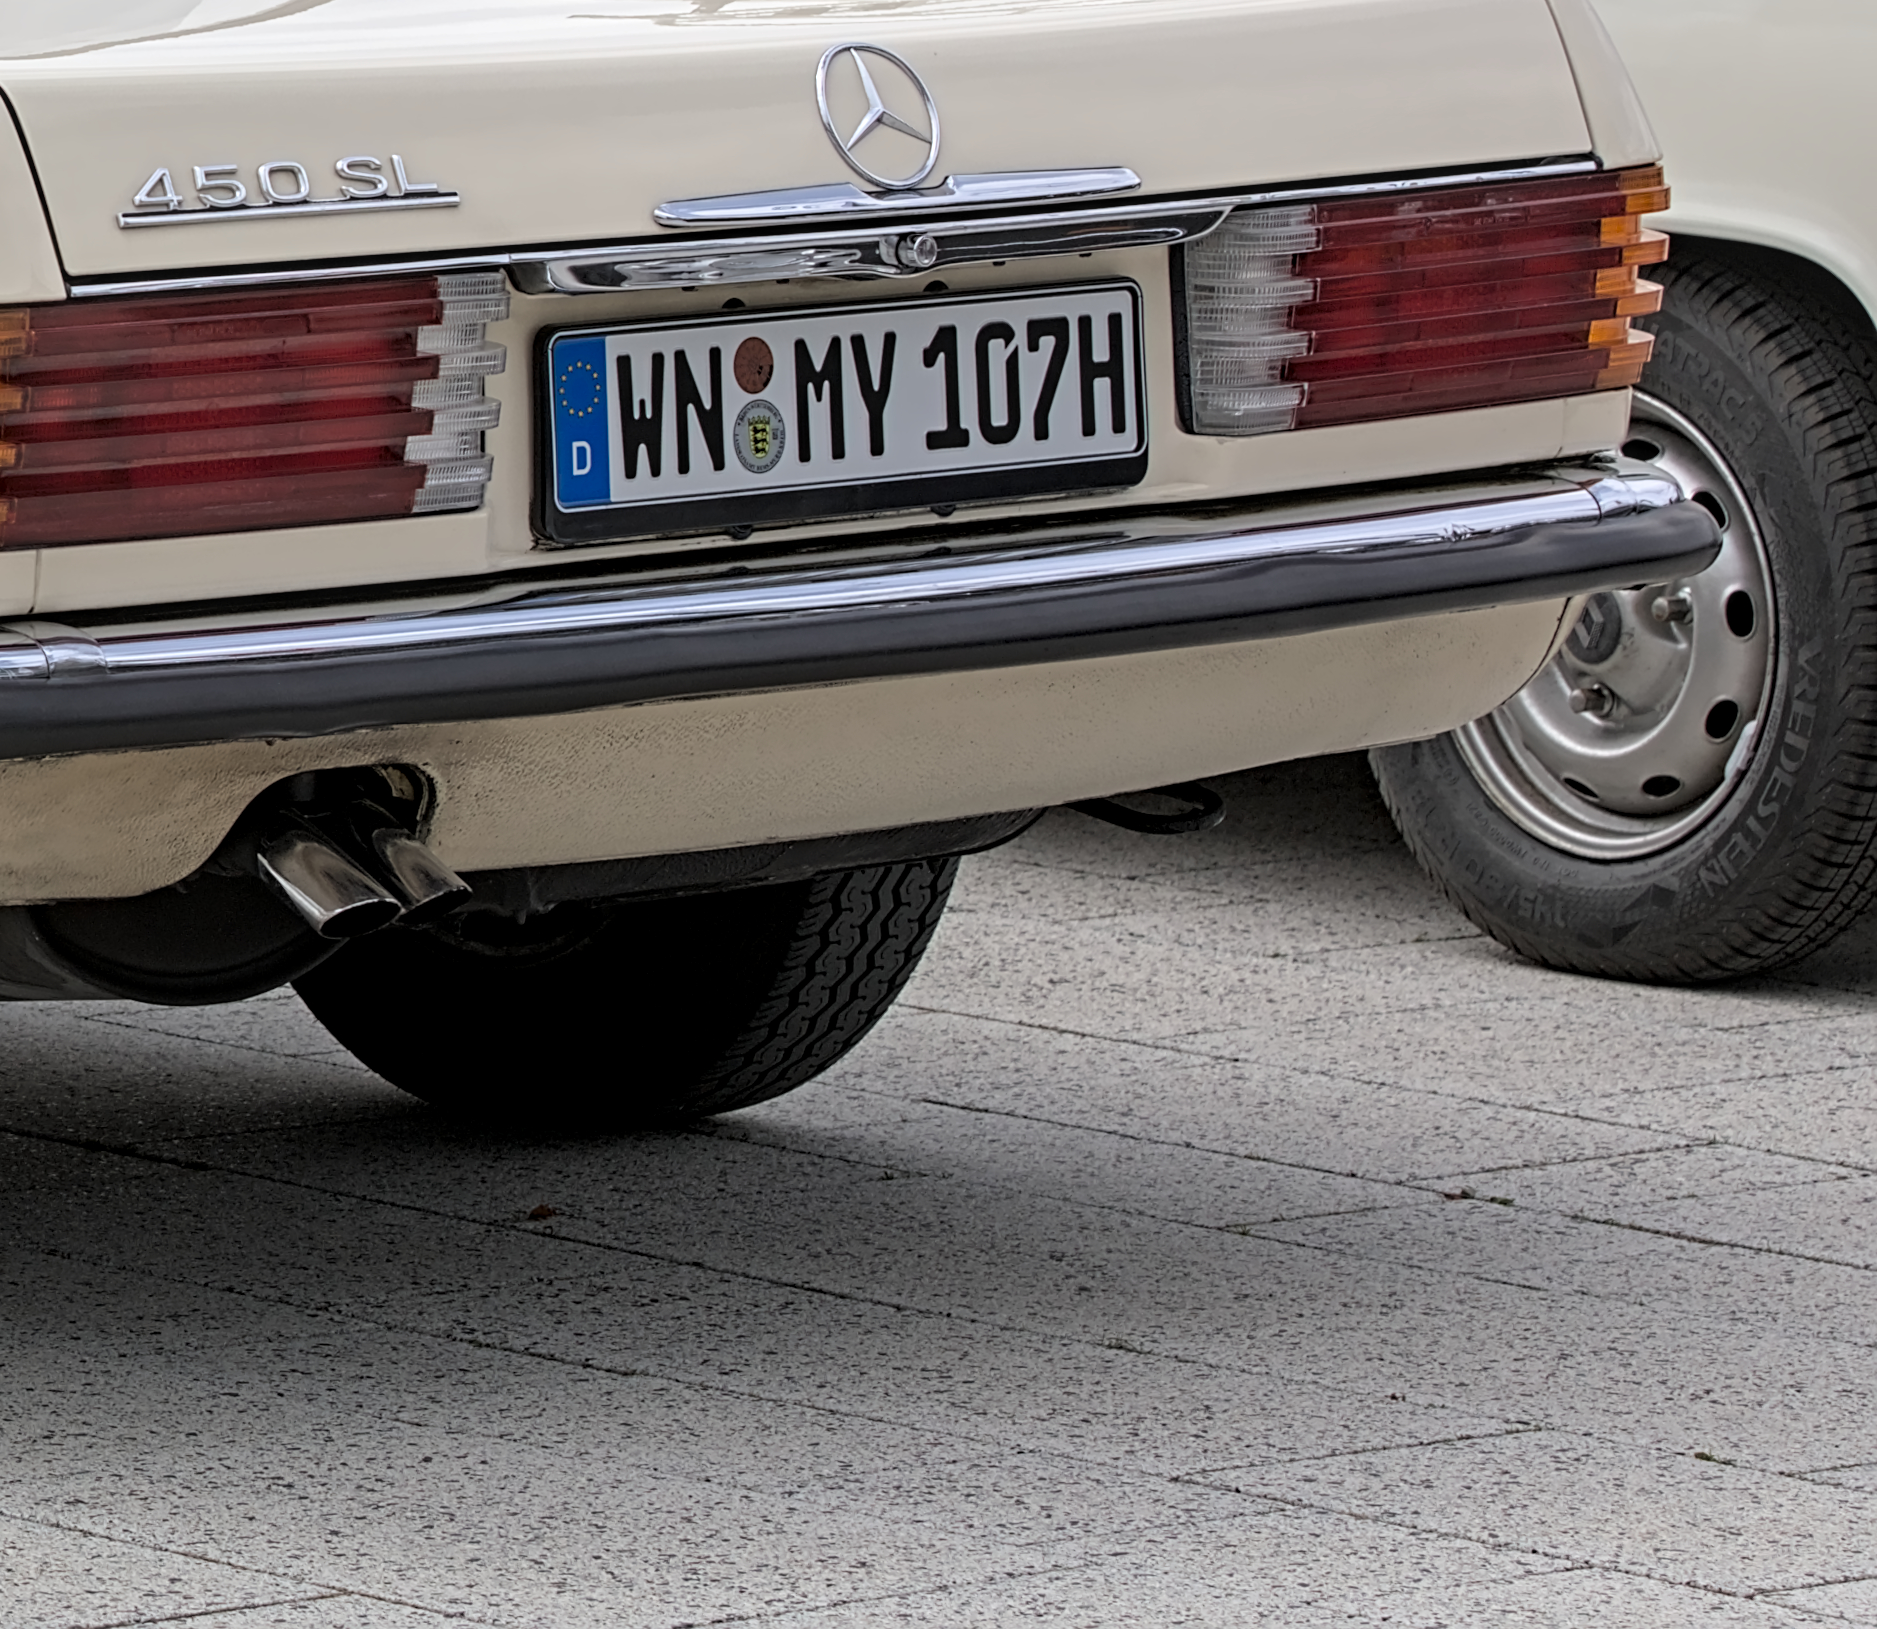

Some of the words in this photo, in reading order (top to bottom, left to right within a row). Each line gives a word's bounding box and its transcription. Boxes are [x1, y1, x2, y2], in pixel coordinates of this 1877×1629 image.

[132, 160, 310, 210] 450
[335, 154, 438, 199] SL
[616, 346, 726, 480] WN
[794, 331, 896, 464] MY
[923, 311, 1126, 451] 107H
[571, 440, 593, 476] D
[1700, 637, 1823, 897] VREDESTEIN
